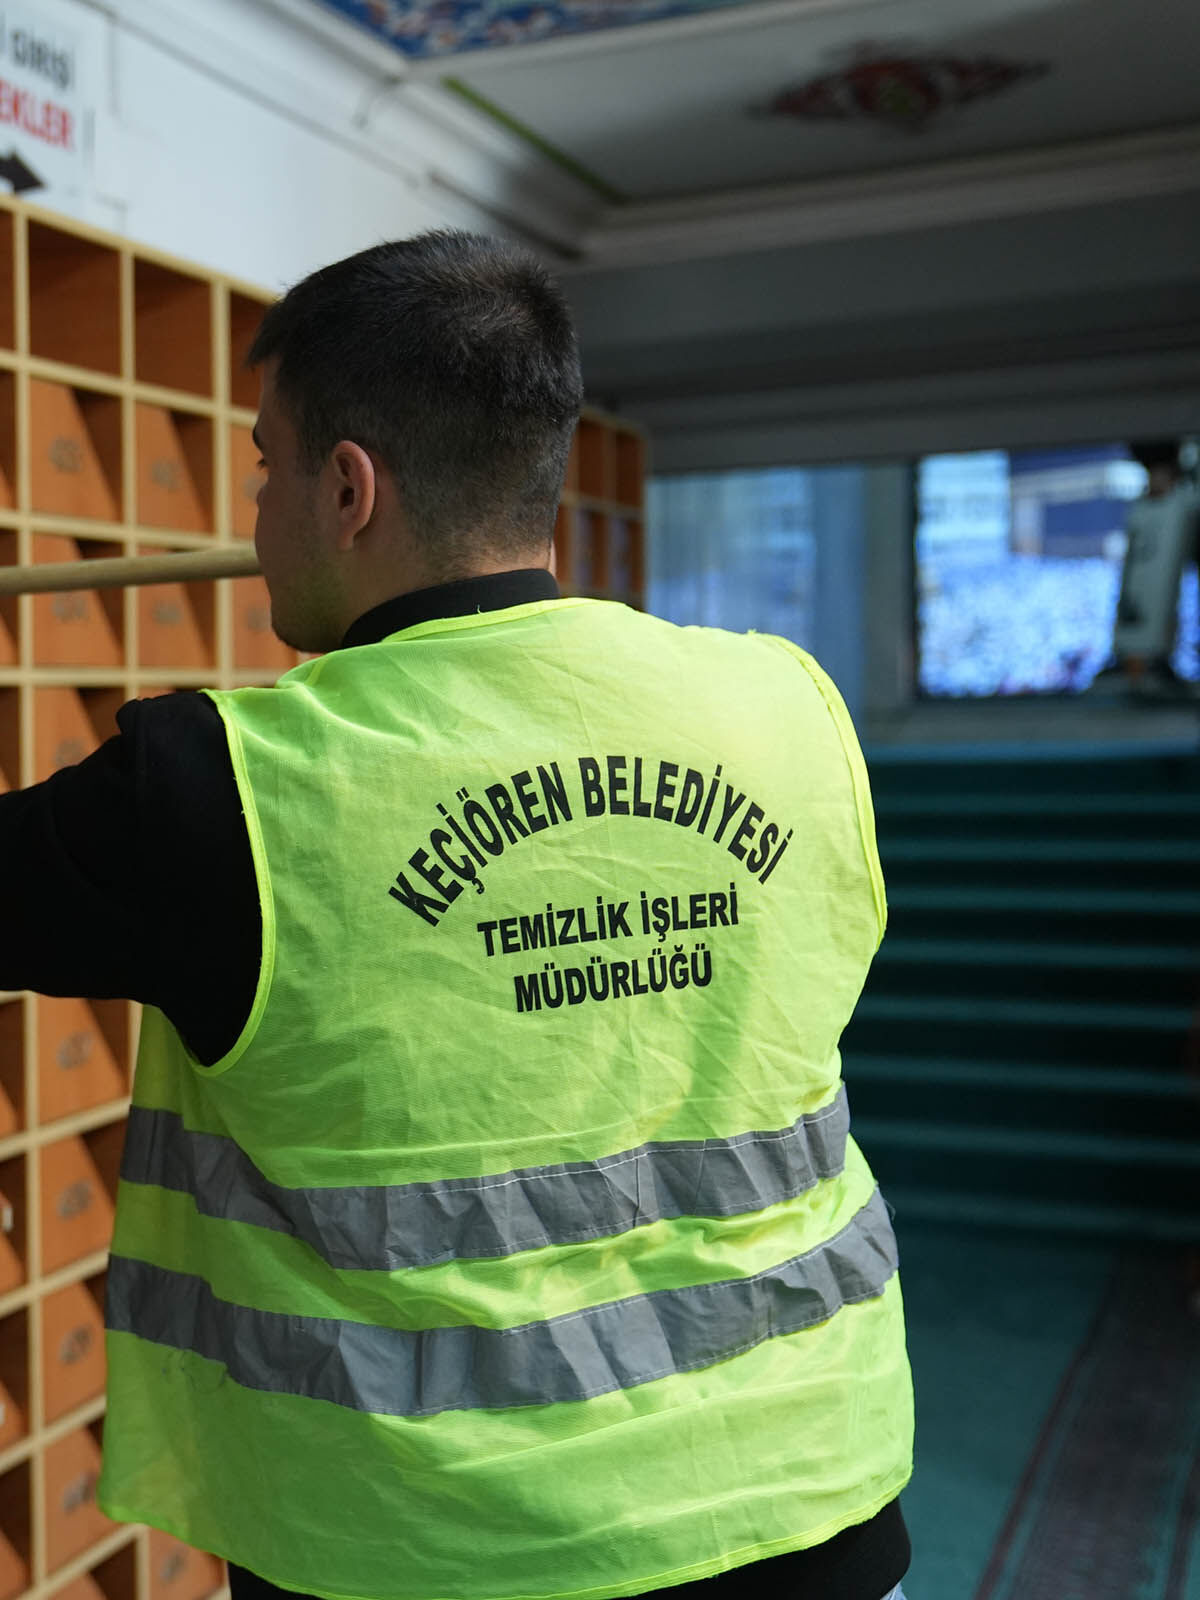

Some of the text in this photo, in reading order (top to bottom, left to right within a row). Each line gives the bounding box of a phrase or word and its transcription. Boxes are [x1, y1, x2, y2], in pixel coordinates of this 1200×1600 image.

[388, 755, 793, 927] KEÇİÖREN BELEDİYESİ
[477, 881, 739, 956] TEMİZLİK İŞLERİ
[513, 942, 713, 1012] MÜDÜRLÜĞÜ
